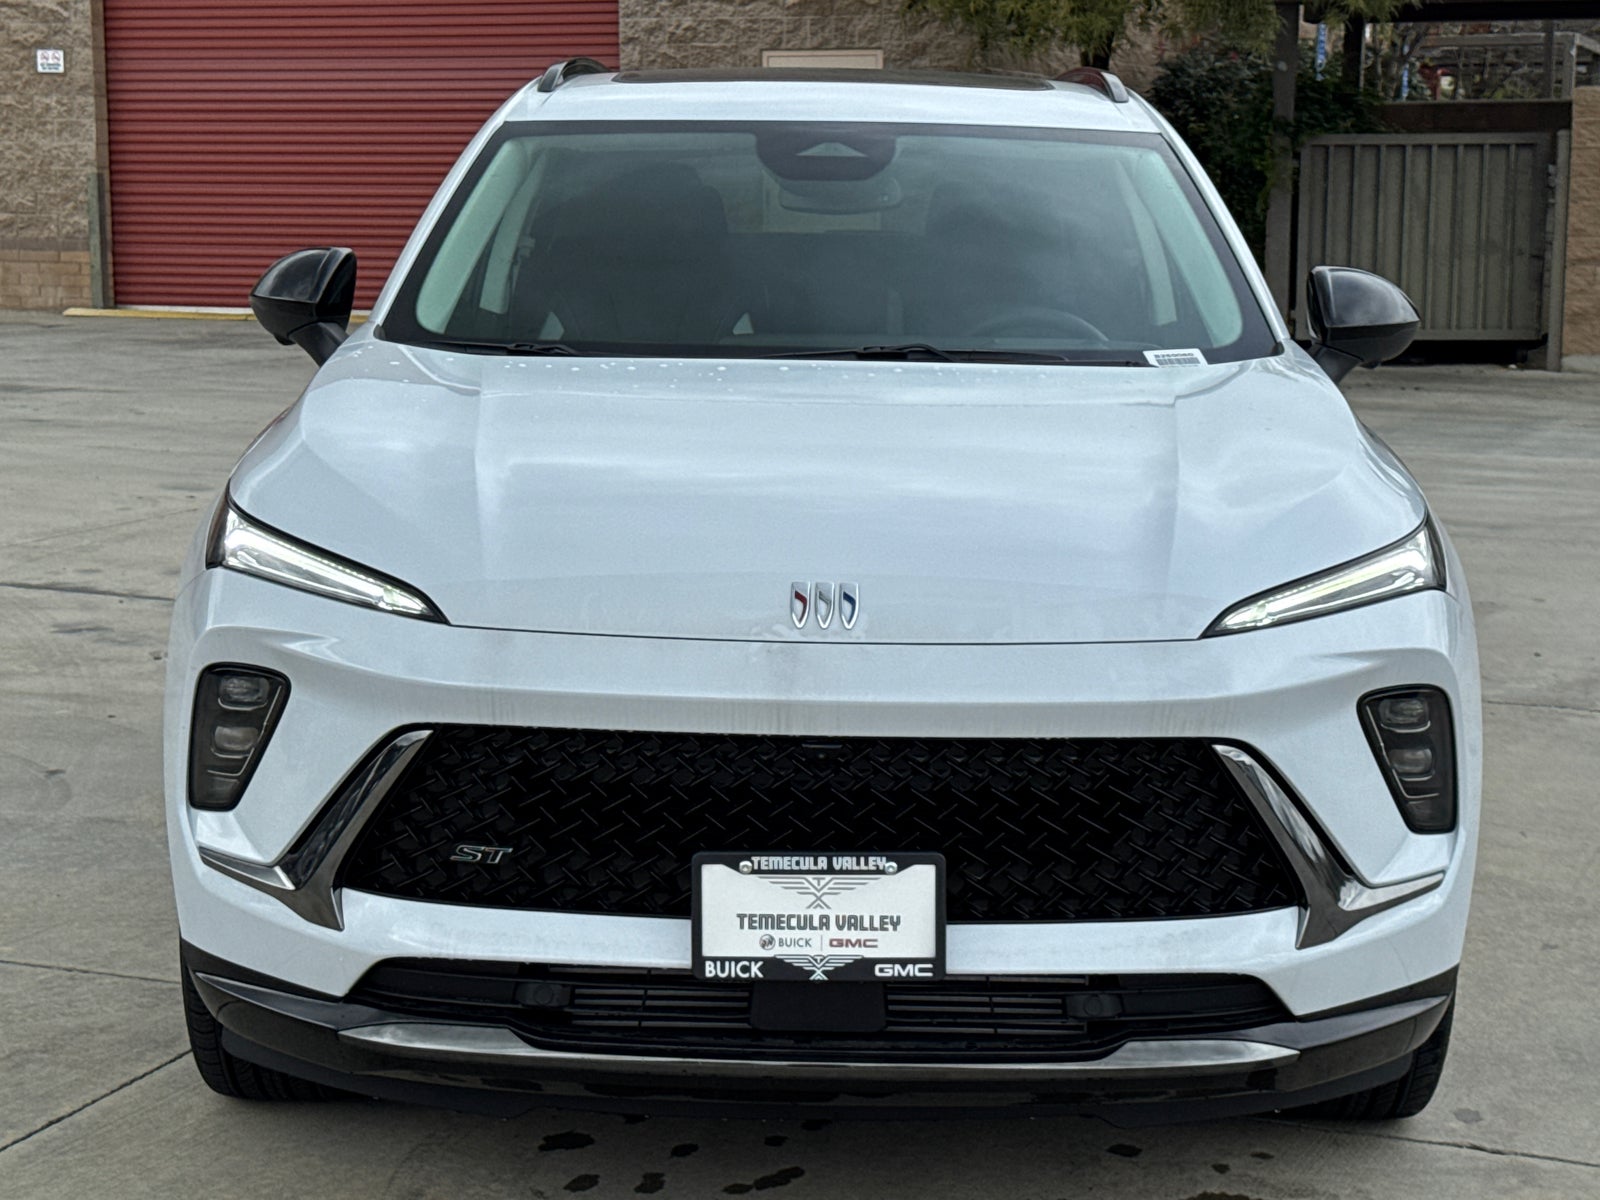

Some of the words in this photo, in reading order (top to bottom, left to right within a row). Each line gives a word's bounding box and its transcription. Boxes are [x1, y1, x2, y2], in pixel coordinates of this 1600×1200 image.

[449, 844, 513, 864] ST
[751, 856, 828, 871] TEMECULA
[832, 856, 887, 871] VALLEY
[736, 913, 830, 931] TEMECULA
[835, 914, 901, 932] VALLEY
[778, 937, 812, 948] BUICK
[829, 938, 878, 948] GMC
[704, 960, 764, 978] BUICK
[874, 963, 934, 977] GMC
